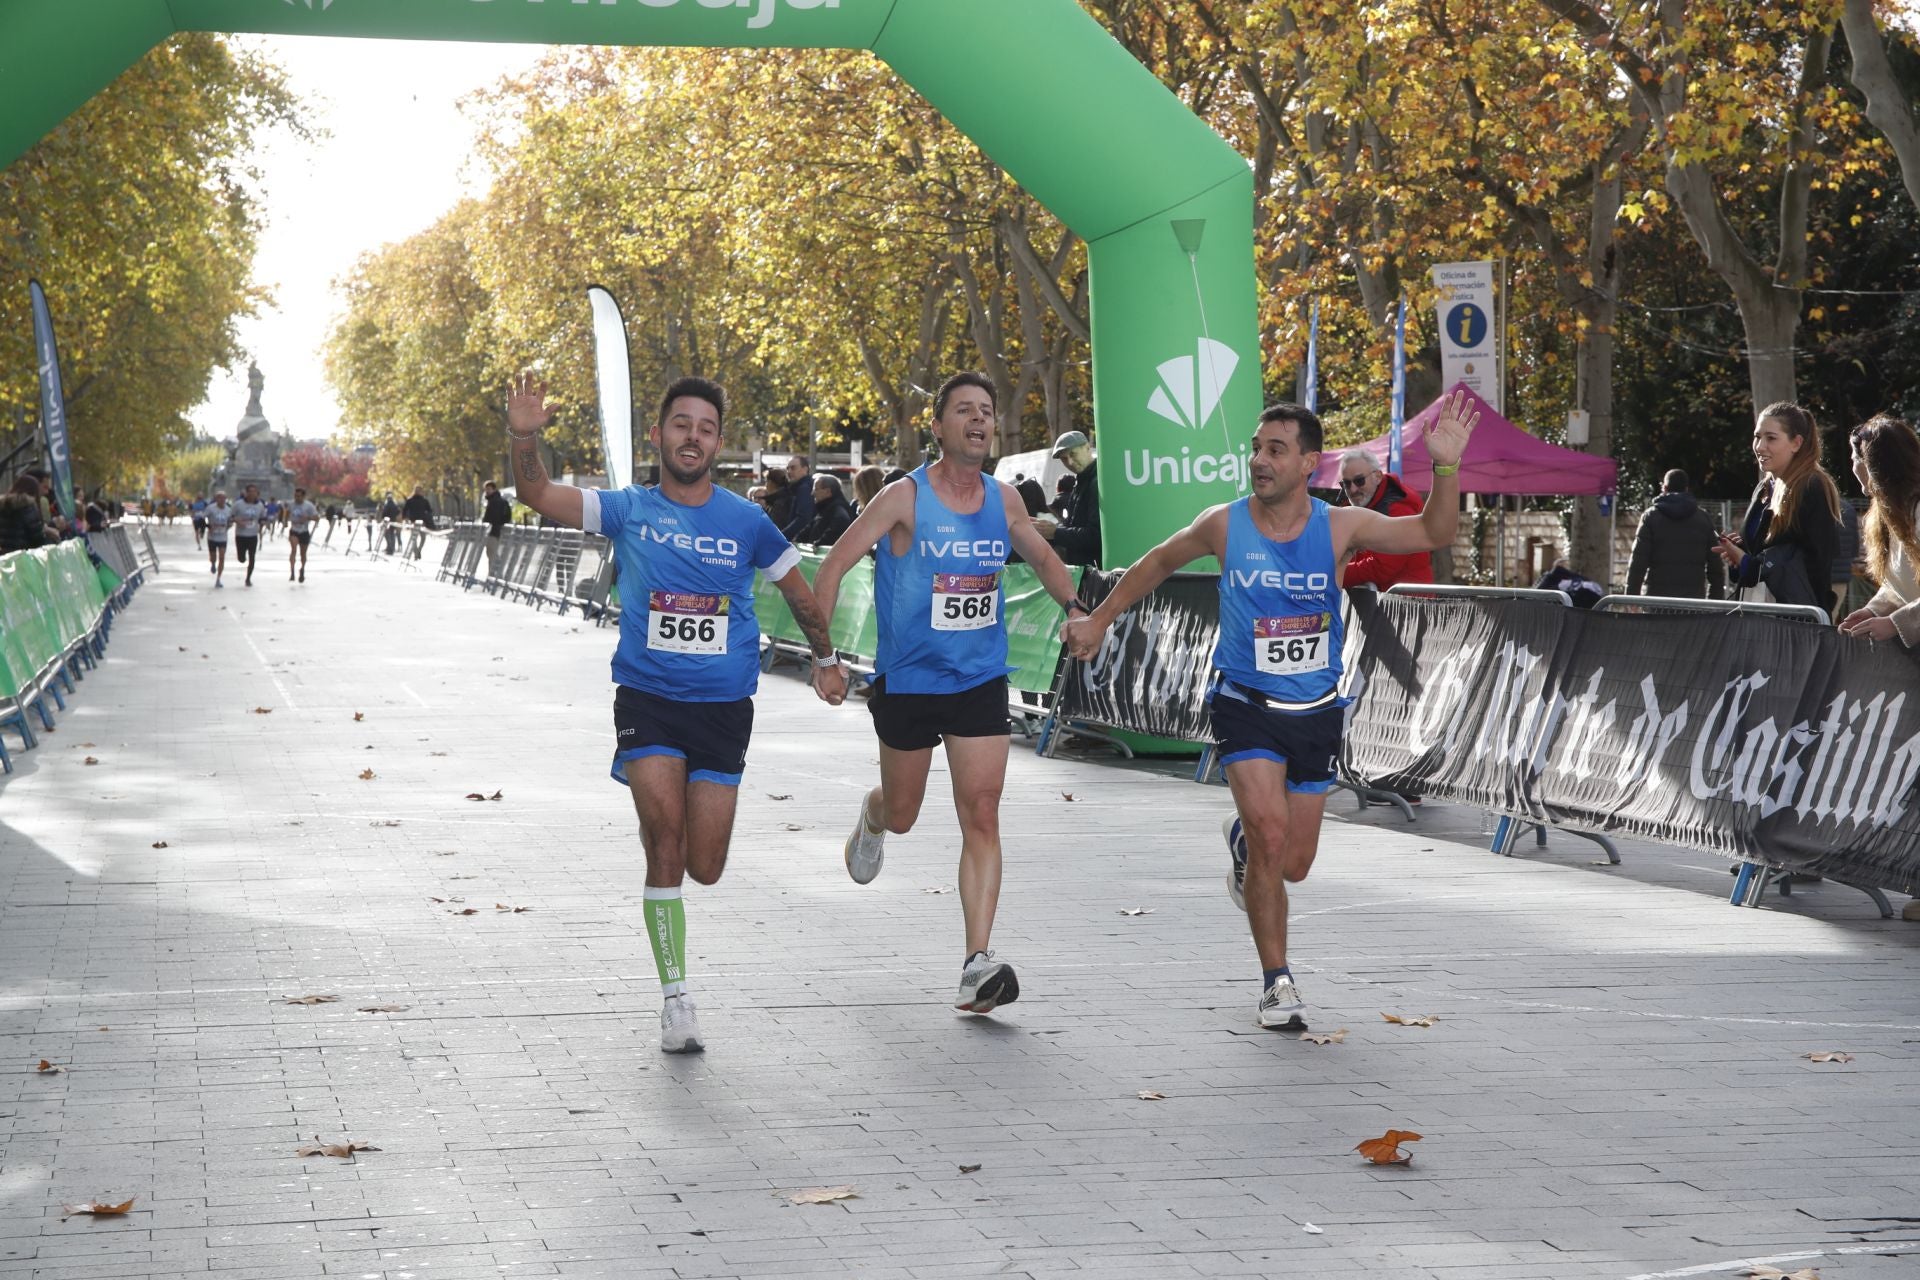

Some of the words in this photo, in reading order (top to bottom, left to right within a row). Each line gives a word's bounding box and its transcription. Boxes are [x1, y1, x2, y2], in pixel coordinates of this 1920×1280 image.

[1440, 272, 1466, 280] Oficina
[1467, 271, 1476, 279] de
[1442, 281, 1486, 289] Inrmación
[1124, 443, 1252, 491] Unicaj
[640, 524, 738, 556] IVECO
[920, 540, 1004, 558] IVECO
[702, 556, 737, 569] running
[1229, 569, 1328, 591] IVECO
[943, 595, 992, 619] 568
[1291, 592, 1325, 601] running
[659, 615, 715, 643] 566
[1267, 637, 1320, 664] 567
[1410, 641, 1486, 757] El
[1475, 640, 1617, 784] Norte
[1614, 673, 1688, 793] de
